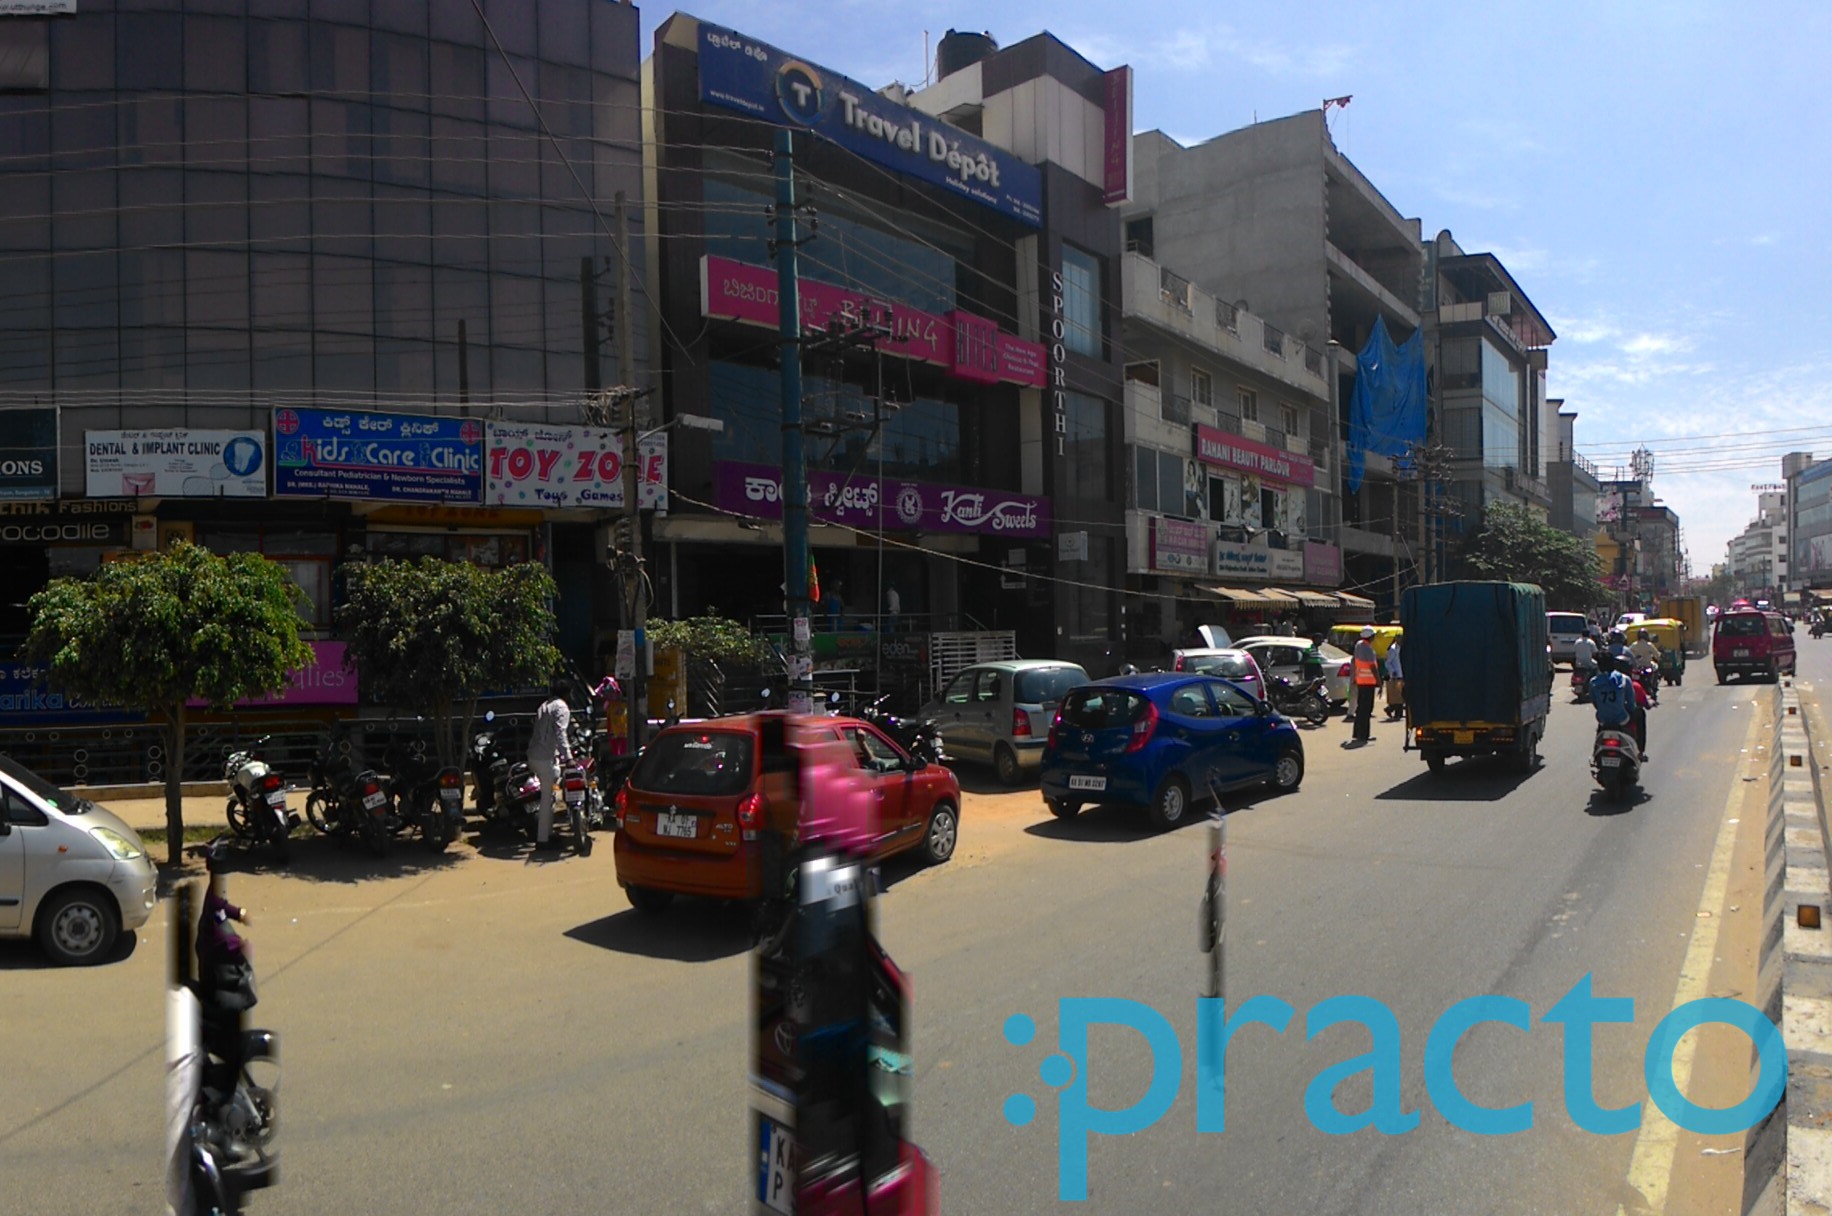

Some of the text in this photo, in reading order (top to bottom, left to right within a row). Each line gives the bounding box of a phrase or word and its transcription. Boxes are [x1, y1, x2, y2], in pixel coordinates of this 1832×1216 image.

[839, 90, 920, 152] Travel
[1052, 271, 1067, 457] SPOORTHI
[90, 442, 221, 455] DENTAL & IMPLANT CLINIC
[366, 443, 416, 467] Care
[430, 447, 479, 475] Clinic
[1231, 447, 1259, 469] BEAUTY
[489, 447, 562, 483] TOY
[294, 469, 466, 486] Consultant Pediatrician & Newborn Specialists
[535, 489, 623, 502] Toys Games
[59, 499, 136, 515] Fashions
[941, 490, 1039, 530] Kanti Sweets
[1600, 690, 1617, 703] 73
